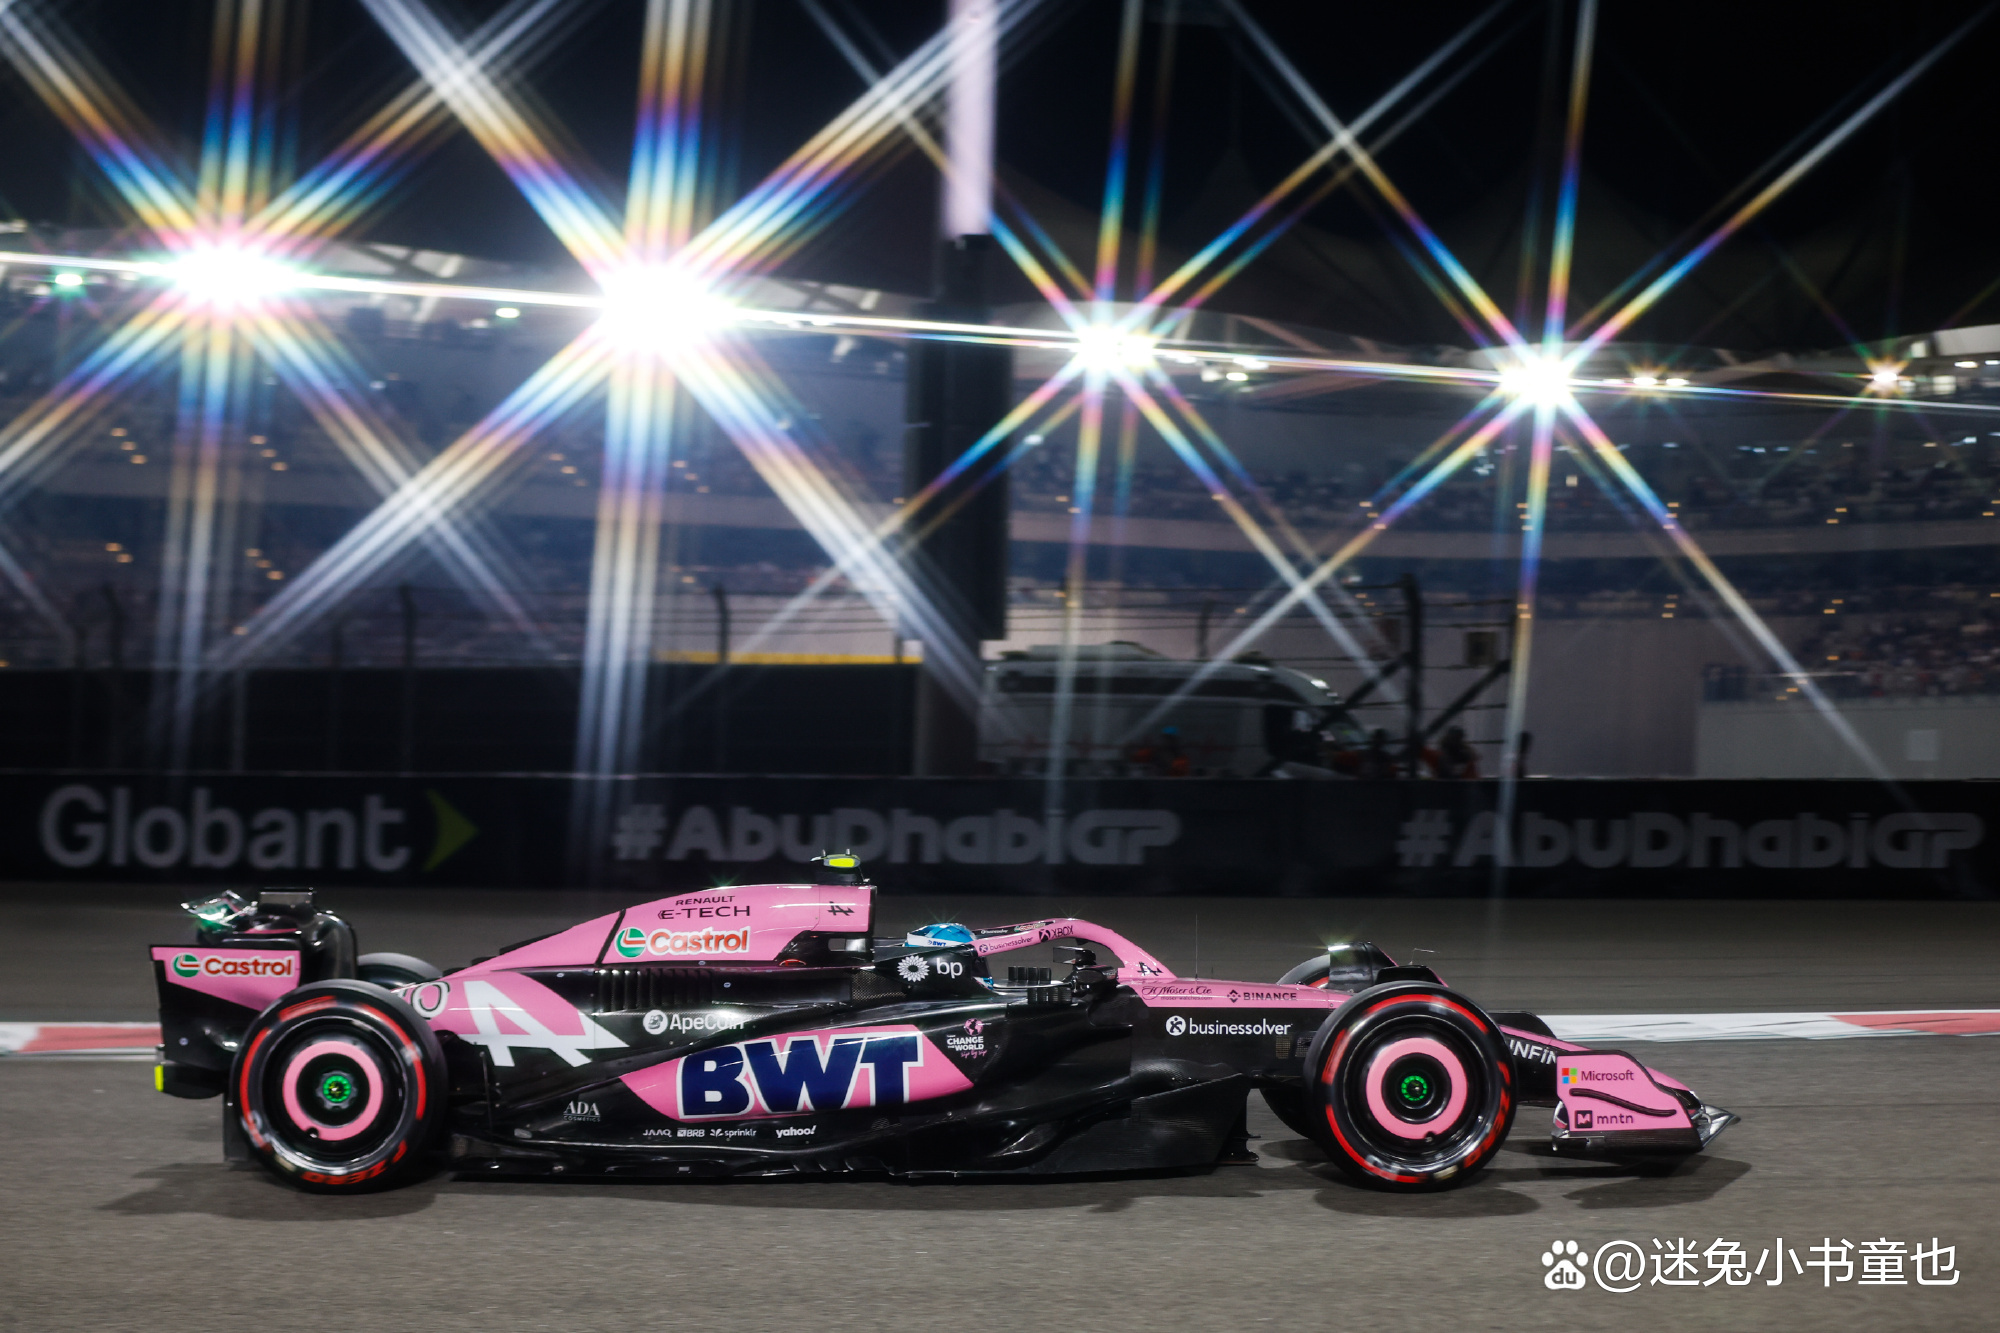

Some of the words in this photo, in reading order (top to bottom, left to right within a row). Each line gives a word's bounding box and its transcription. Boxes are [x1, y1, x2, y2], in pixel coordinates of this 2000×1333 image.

[39, 784, 411, 872] Globant
[612, 803, 1182, 866] #AbuDhabiGP
[1396, 809, 1965, 868] #AbuDhabiGP
[675, 896, 735, 906] RENAULT
[657, 906, 750, 920] E-TECH
[1051, 925, 1074, 939] XBOX
[649, 927, 750, 955] Castrol
[989, 936, 1034, 951] businessolver
[204, 957, 293, 976] Castrol
[936, 957, 964, 979] bp
[1243, 992, 1298, 1001] BINANCE
[1189, 1017, 1292, 1035] businessolver
[946, 1036, 984, 1045] CHANGE
[676, 1031, 924, 1120] BWT
[1580, 1069, 1634, 1081] Microsoft
[563, 1100, 600, 1116] ADA
[1596, 1113, 1634, 1124] mntn
[687, 1129, 705, 1138] BRB
[724, 1128, 757, 1139] sprinklr
[776, 1125, 817, 1138] yahoo!
